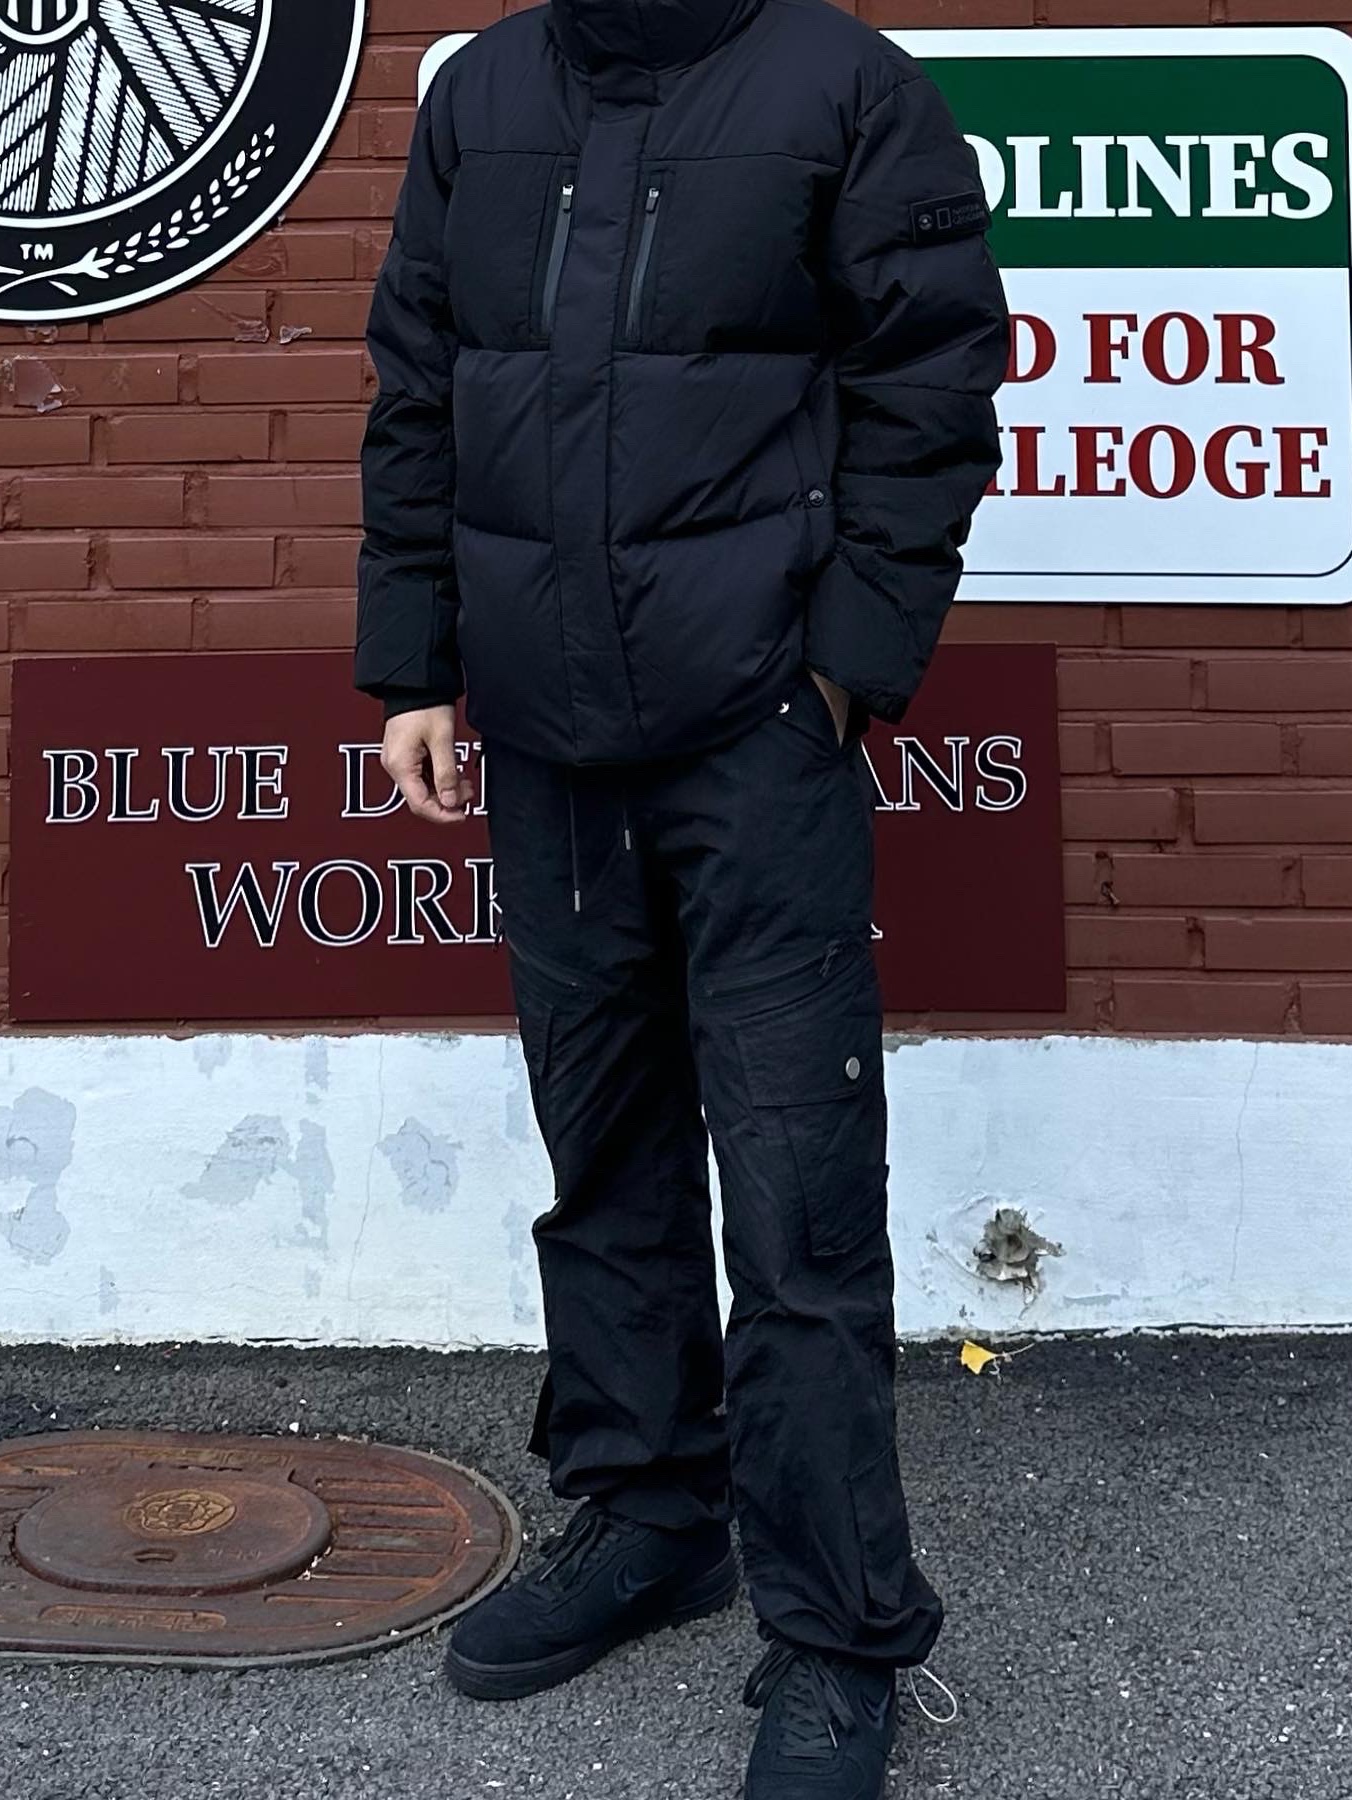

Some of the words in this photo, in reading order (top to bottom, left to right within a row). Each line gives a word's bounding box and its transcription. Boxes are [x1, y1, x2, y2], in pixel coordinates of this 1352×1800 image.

[20, 243, 54, 260] TM
[1082, 311, 1285, 385] FOR
[981, 424, 1332, 499] LEOGE
[43, 745, 290, 824] BLUE
